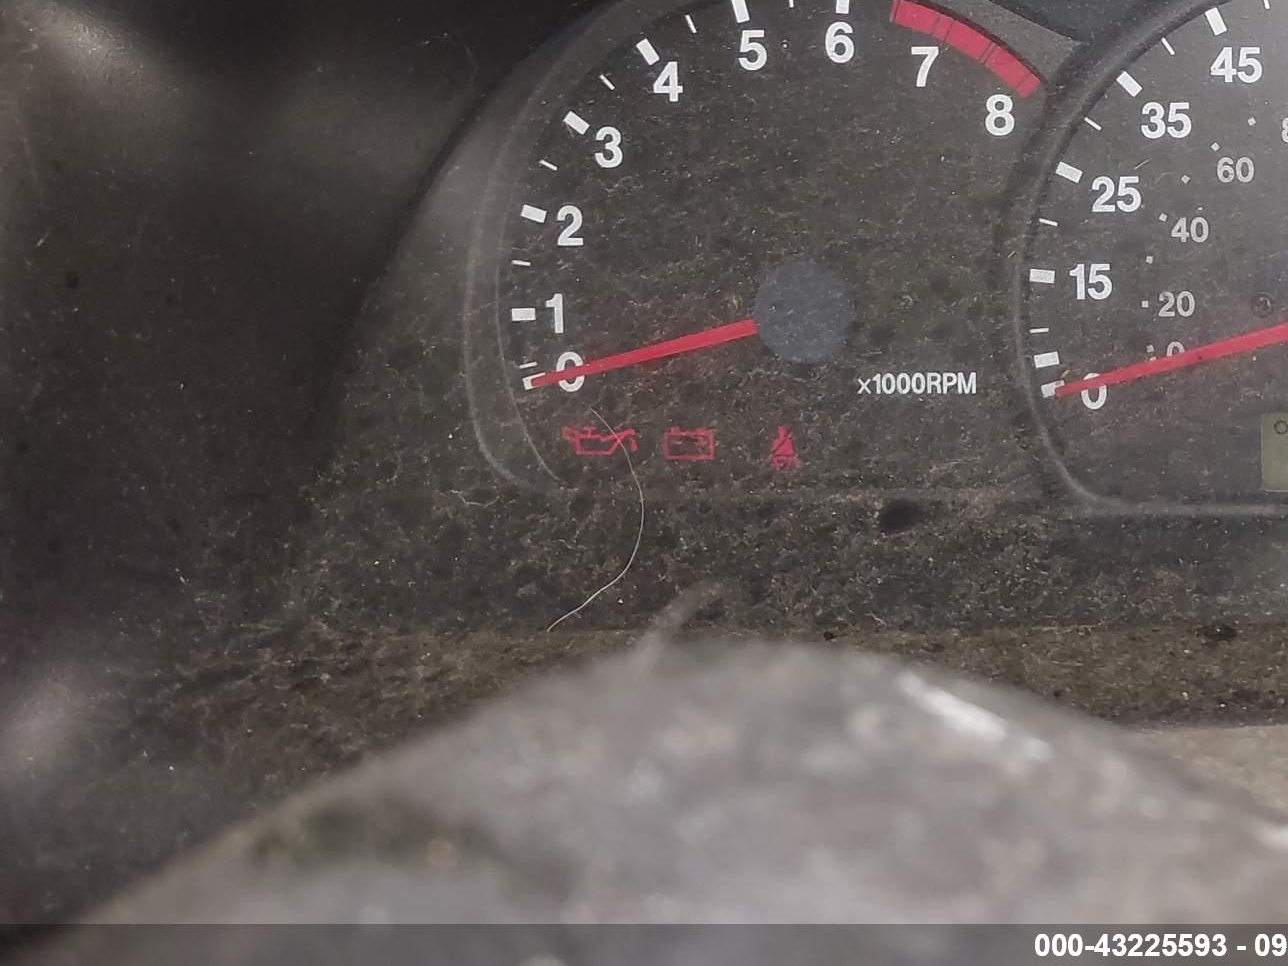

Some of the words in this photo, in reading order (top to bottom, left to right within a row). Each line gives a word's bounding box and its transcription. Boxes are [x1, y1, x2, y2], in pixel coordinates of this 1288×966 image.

[738, 29, 768, 71] 5
[826, 21, 855, 63] 6
[653, 61, 684, 102] 4
[911, 47, 940, 87] 7
[1210, 46, 1263, 84] 45
[985, 94, 1015, 136] 8
[1140, 101, 1192, 140] 35
[594, 126, 624, 169] 3
[1216, 157, 1255, 184] 60
[1091, 176, 1143, 213] 25
[556, 205, 585, 247] 2
[1170, 217, 1209, 244] 40
[1068, 263, 1113, 301] 15
[545, 293, 564, 334] 1
[1158, 290, 1196, 317] 20
